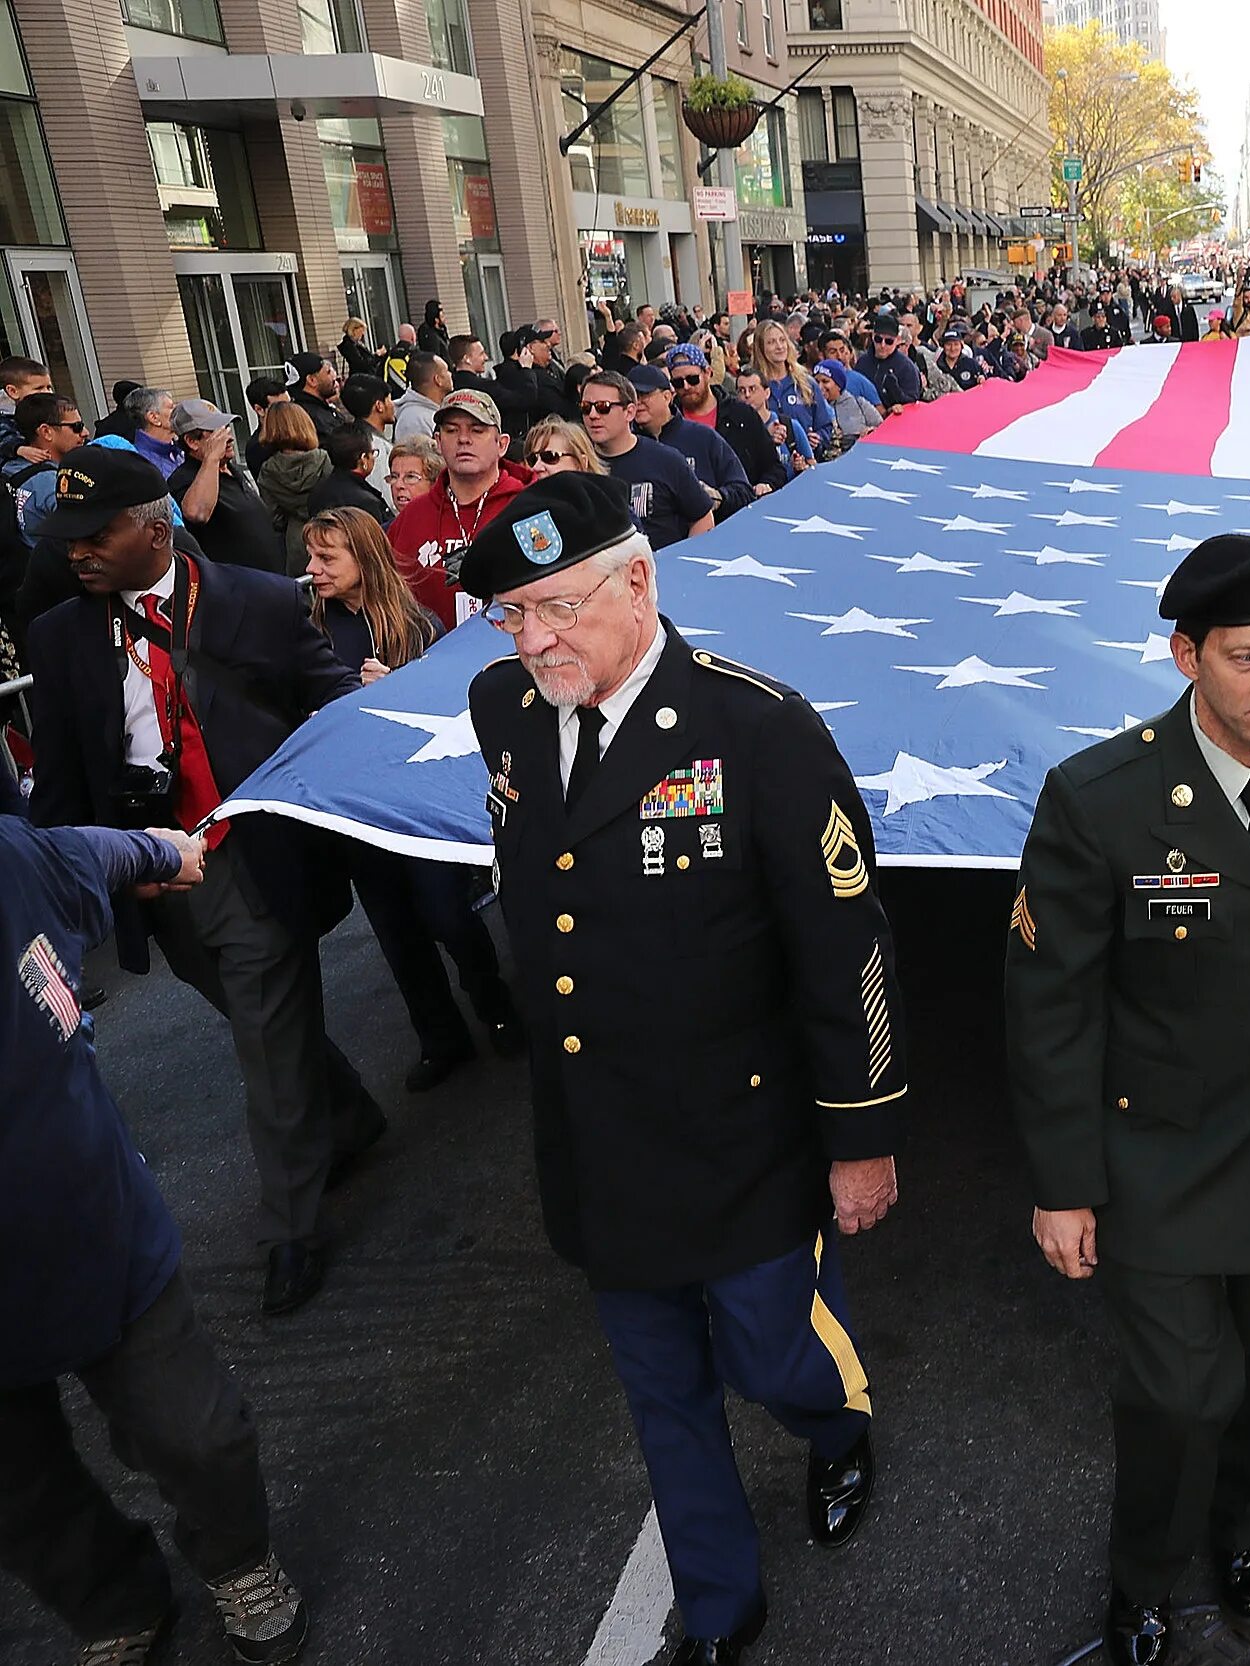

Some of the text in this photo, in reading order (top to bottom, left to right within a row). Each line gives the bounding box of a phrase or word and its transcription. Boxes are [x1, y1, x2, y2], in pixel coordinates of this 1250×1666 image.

[420, 71, 446, 101] 241
[275, 255, 293, 271] 241
[74, 471, 95, 488] CORPS
[113, 617, 122, 647] Canon
